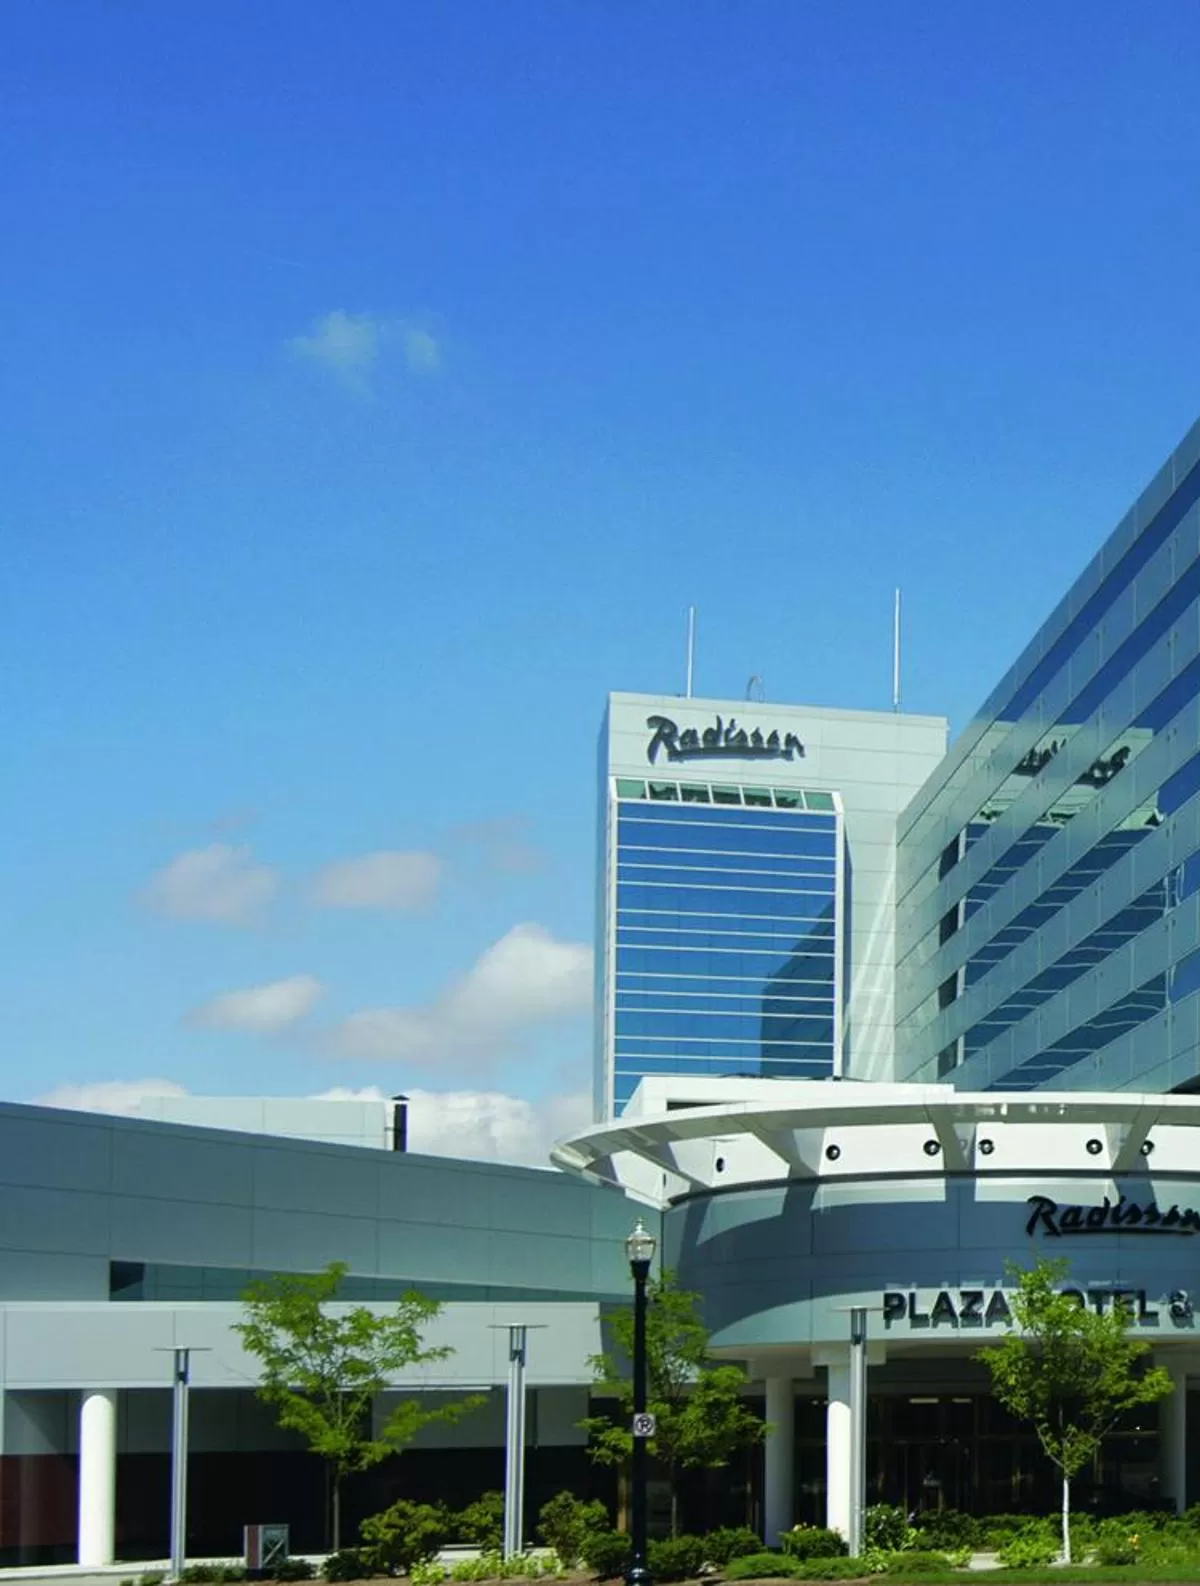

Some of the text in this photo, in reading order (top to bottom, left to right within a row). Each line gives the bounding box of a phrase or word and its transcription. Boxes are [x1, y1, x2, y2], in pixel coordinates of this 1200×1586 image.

[647, 714, 806, 765] Radisson
[883, 1289, 1013, 1325] PLAZA
[1169, 1289, 1194, 1321] &
